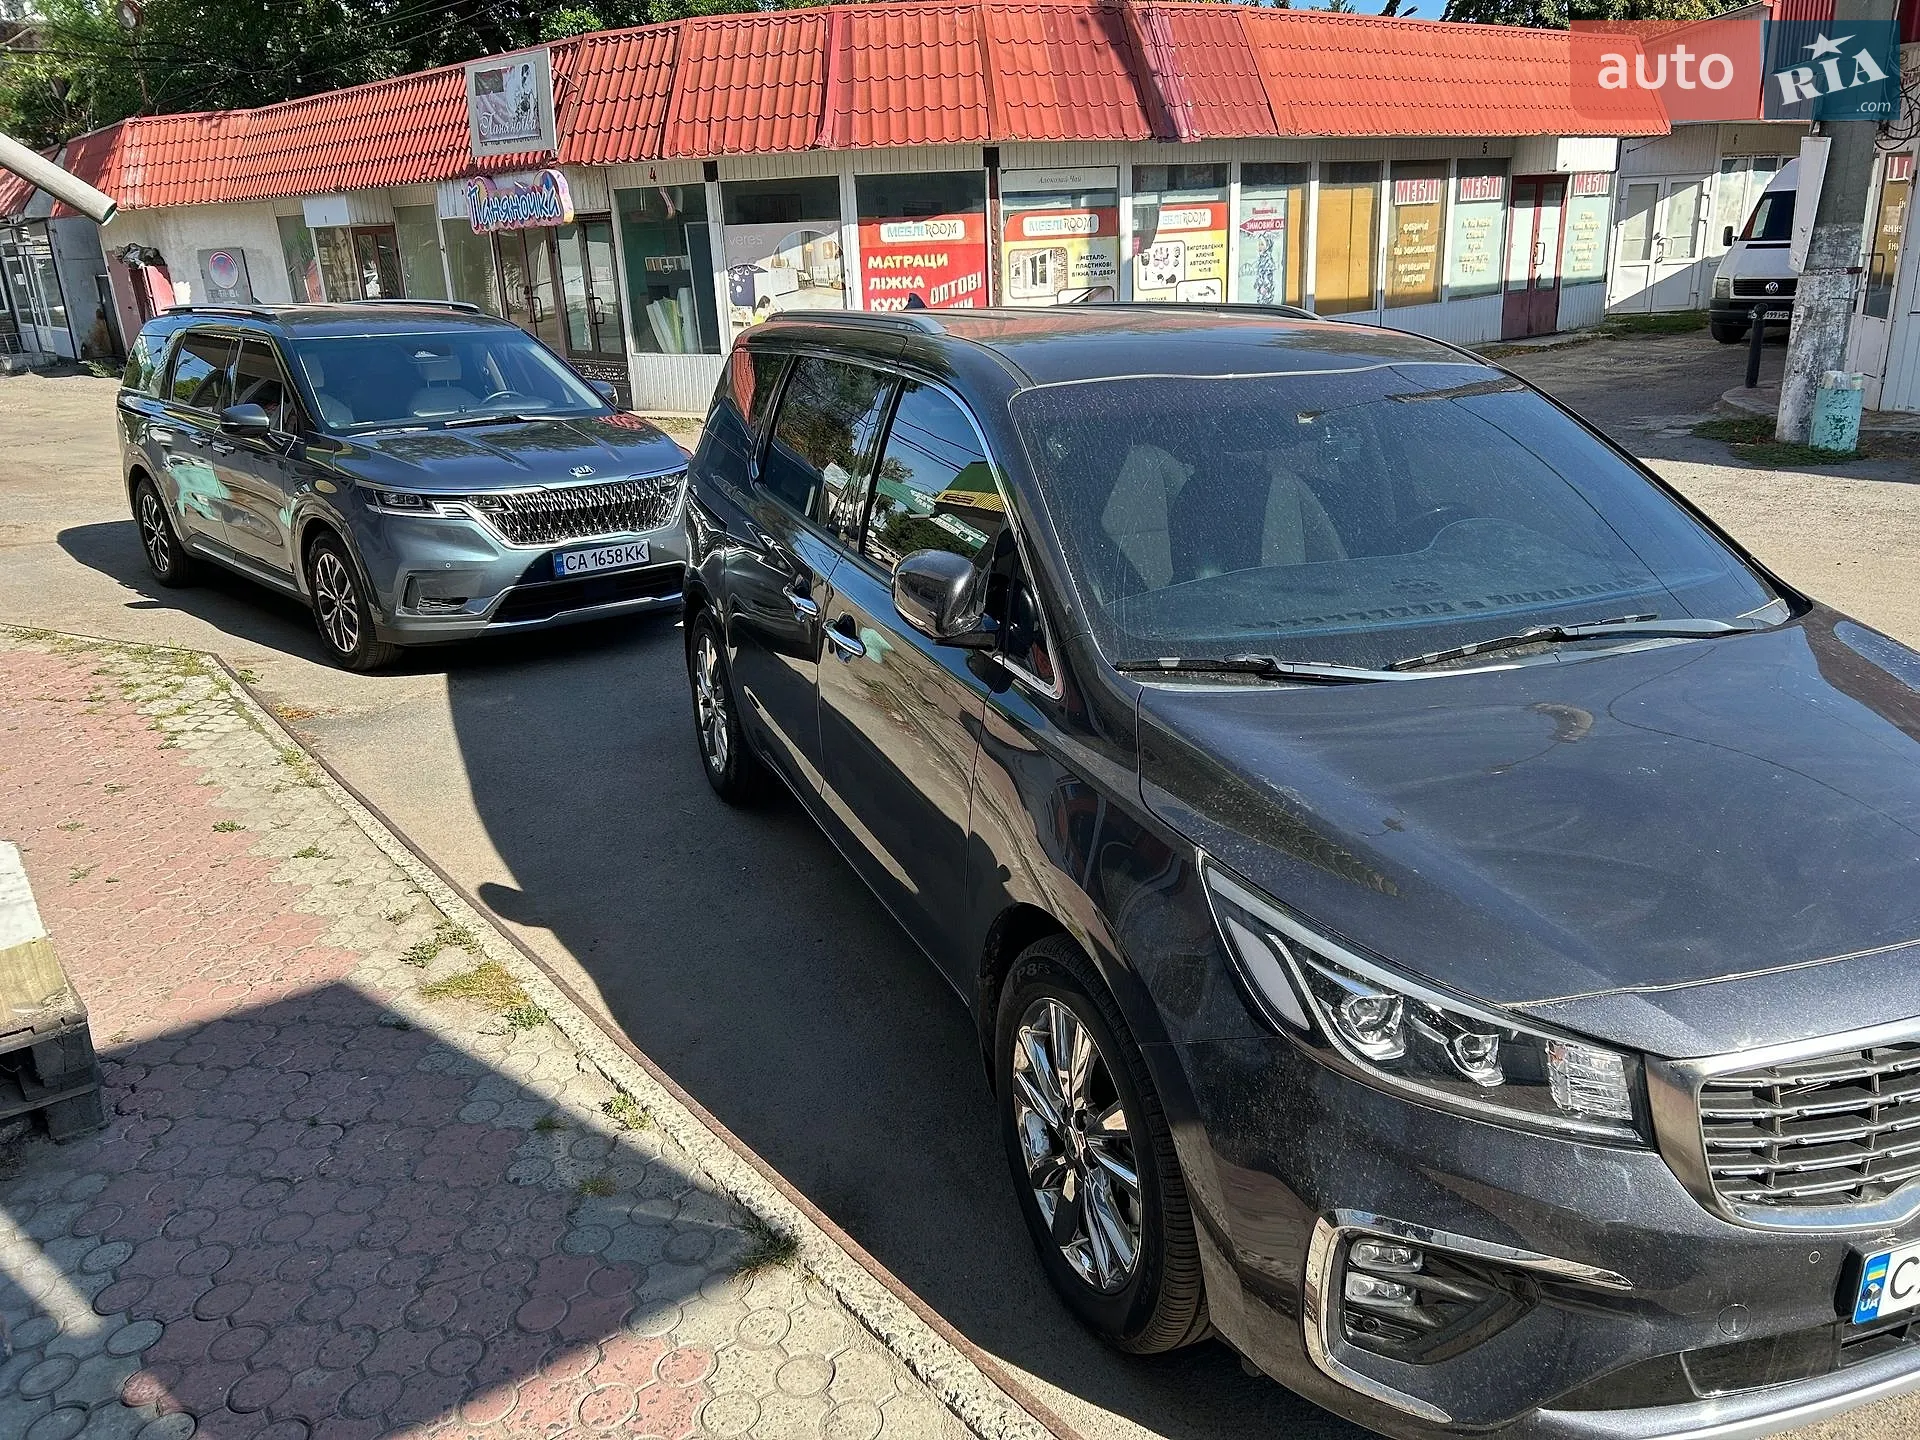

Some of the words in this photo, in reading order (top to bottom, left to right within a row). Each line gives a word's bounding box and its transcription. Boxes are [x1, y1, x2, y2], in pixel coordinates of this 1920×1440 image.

[1482, 142, 1488, 154] 5
[649, 167, 657, 181] 4
[1396, 180, 1439, 203] МЕБЛІ
[1461, 177, 1501, 200] МЕБЛІ
[1575, 174, 1608, 194] МЕБЛІ
[467, 185, 561, 228] Паняночка
[728, 233, 763, 246] veres
[867, 253, 949, 269] МАТРАЦИ
[1098, 269, 1116, 277] ДВЕРІ
[868, 276, 925, 290] ЛІЖКА
[929, 271, 982, 305] ОПТОВІ
[571, 465, 594, 476] KIA
[565, 554, 588, 570] CA
[591, 549, 623, 567] 1658
[625, 544, 646, 562] KK
[1860, 1298, 1878, 1311] UA
